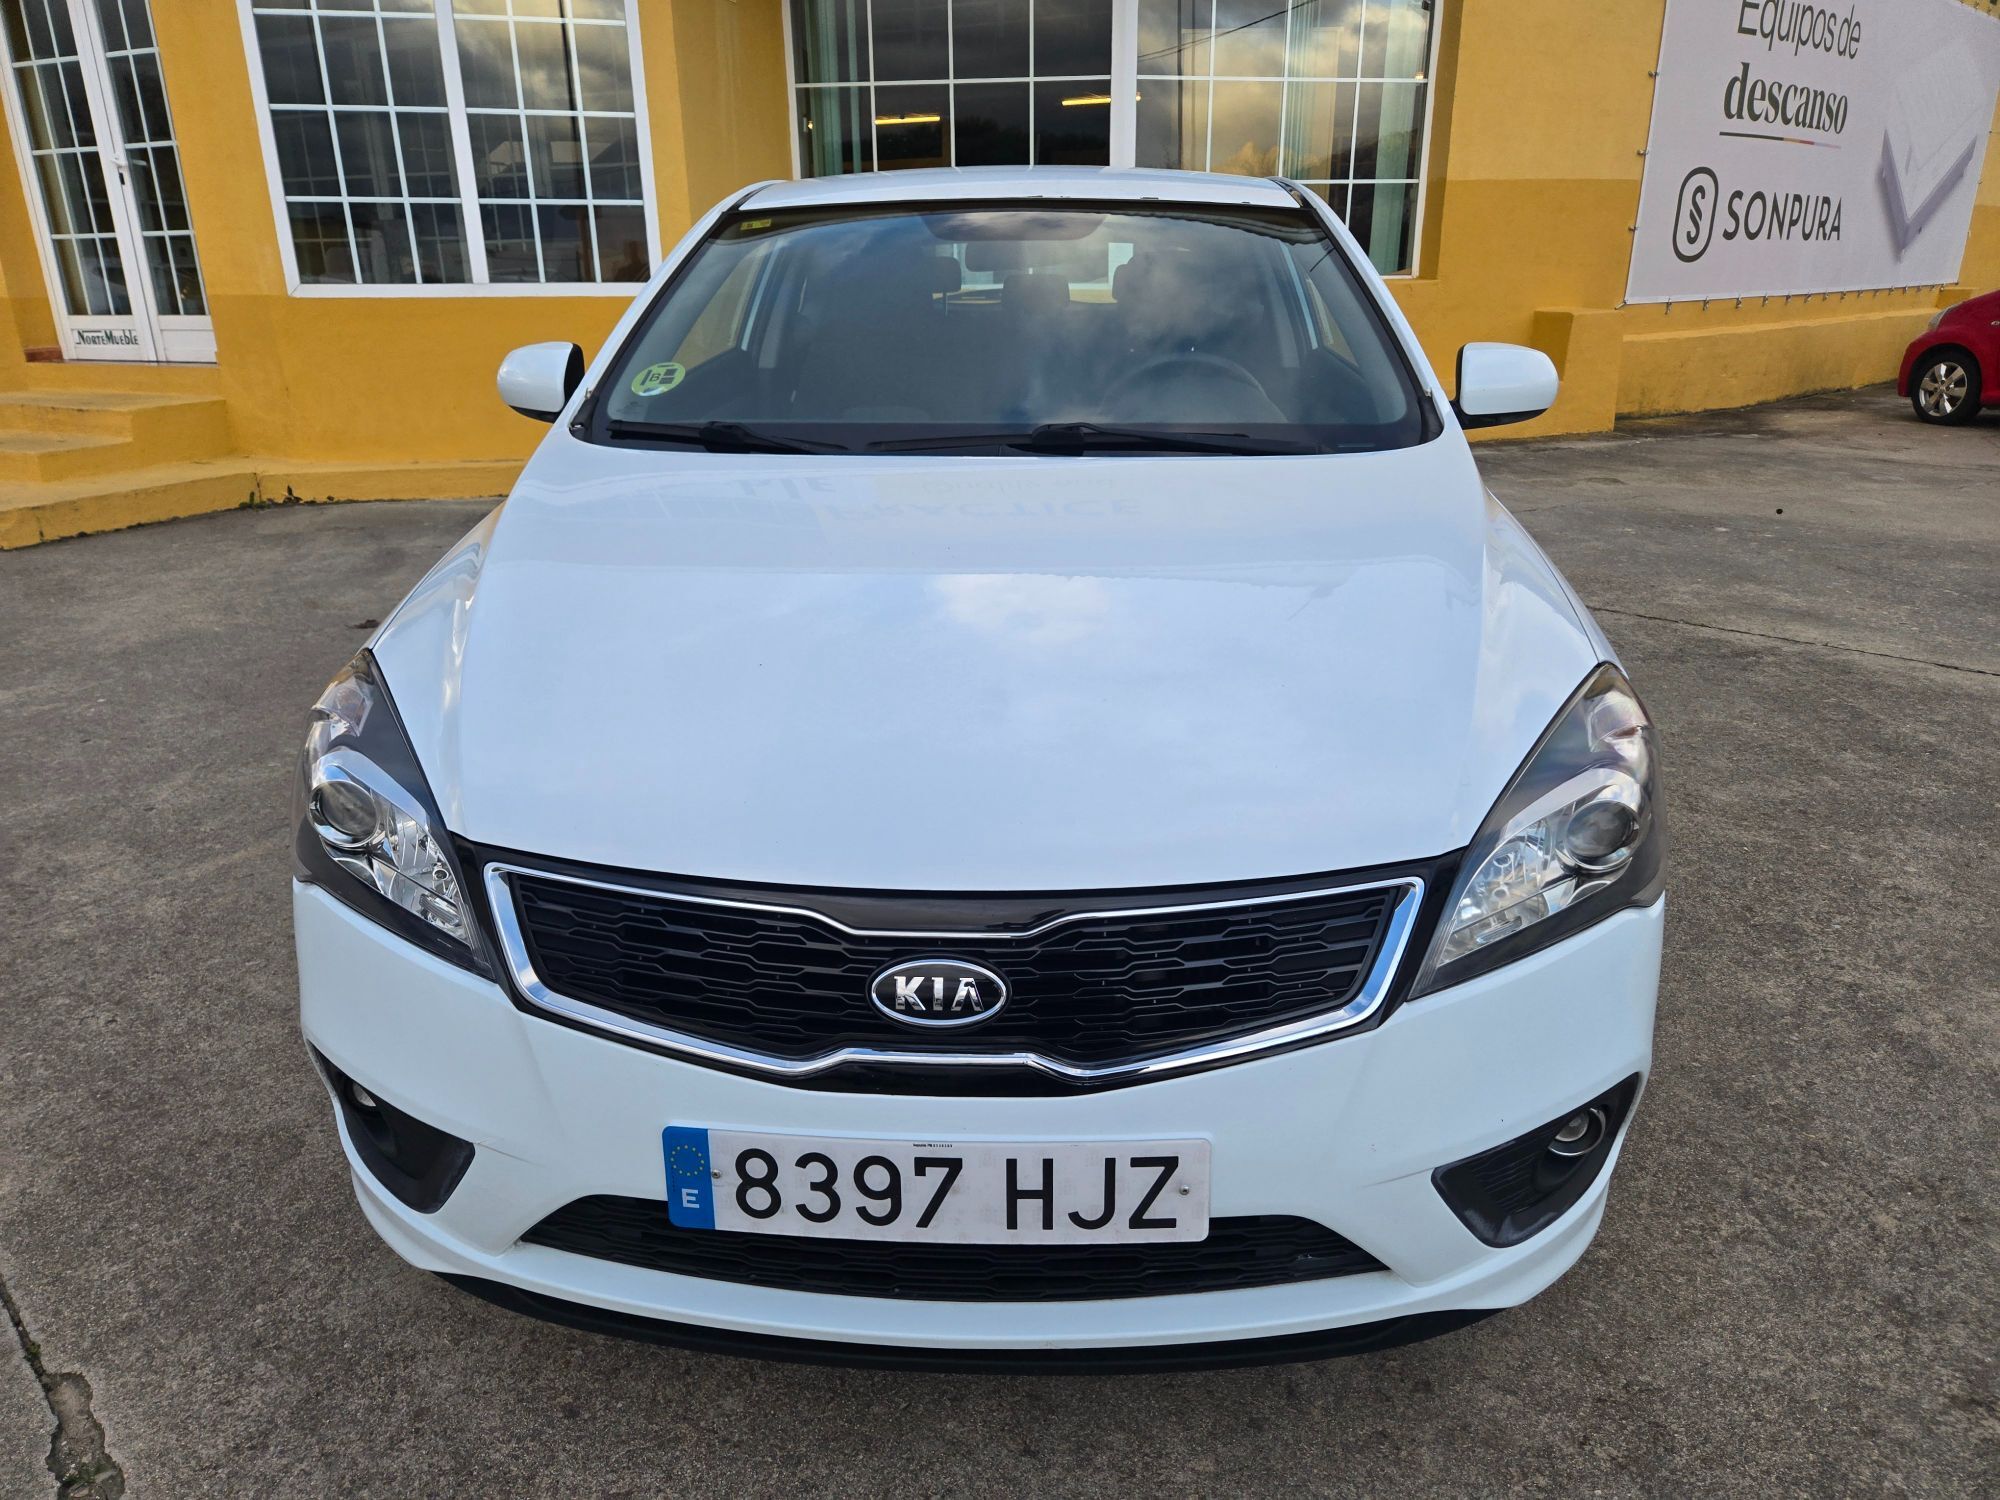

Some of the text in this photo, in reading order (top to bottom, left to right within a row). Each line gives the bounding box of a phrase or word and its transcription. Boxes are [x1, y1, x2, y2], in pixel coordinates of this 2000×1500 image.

[1738, 0, 1861, 59] Equipos de
[1723, 62, 1848, 134] descanso
[1722, 190, 1842, 241] SONPURA
[894, 976, 984, 1011] KIA
[681, 1187, 700, 1209] E
[735, 1148, 1179, 1230] 8397 HJZ
